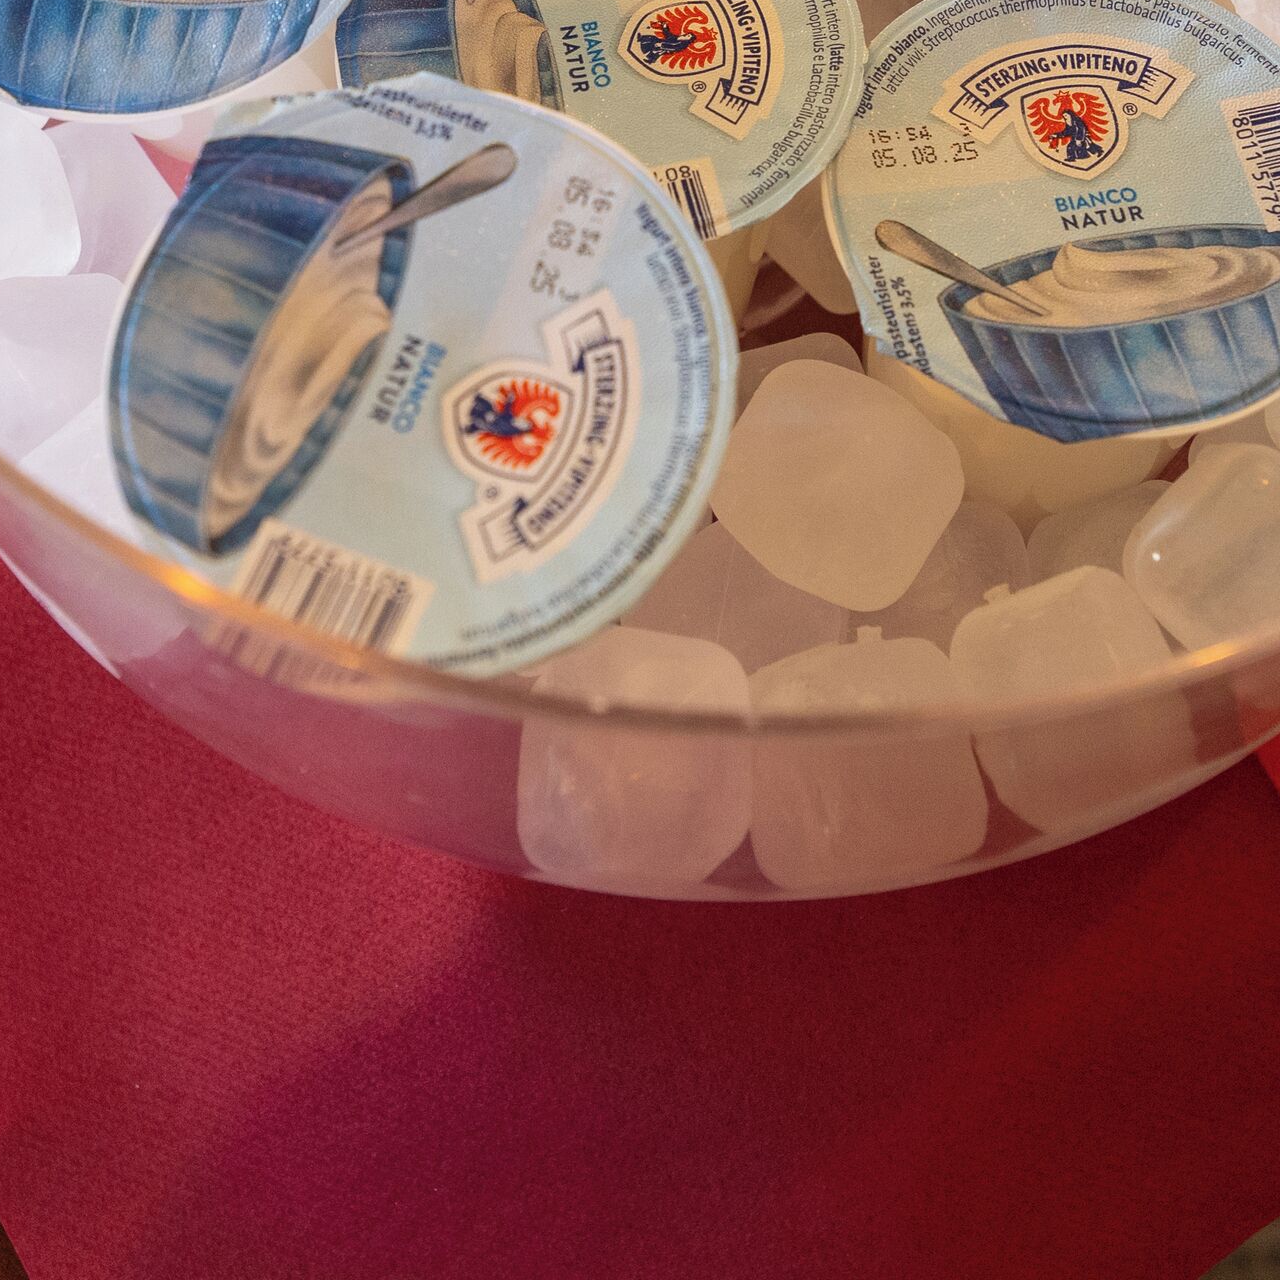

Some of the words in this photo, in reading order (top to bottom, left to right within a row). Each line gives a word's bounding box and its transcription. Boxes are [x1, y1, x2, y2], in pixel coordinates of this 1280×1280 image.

[581, 20, 611, 89] BIANCO
[825, 8, 841, 42] intero
[872, 52, 898, 85] intero
[890, 24, 930, 57] bianco.
[881, 65, 912, 95] lattici
[906, 47, 927, 68] vivi:
[921, 7, 999, 52] Streptococcus
[1183, 20, 1244, 68] bulgaricus.
[560, 24, 590, 94] NATUR
[821, 73, 843, 105] intero
[792, 63, 826, 129] Lactobacillus
[1055, 187, 1138, 212] BIANCO
[1061, 205, 1144, 231] NATUR
[868, 255, 911, 360] pasteurisierter
[890, 276, 915, 309] 3,5%
[371, 334, 423, 424] NATUR
